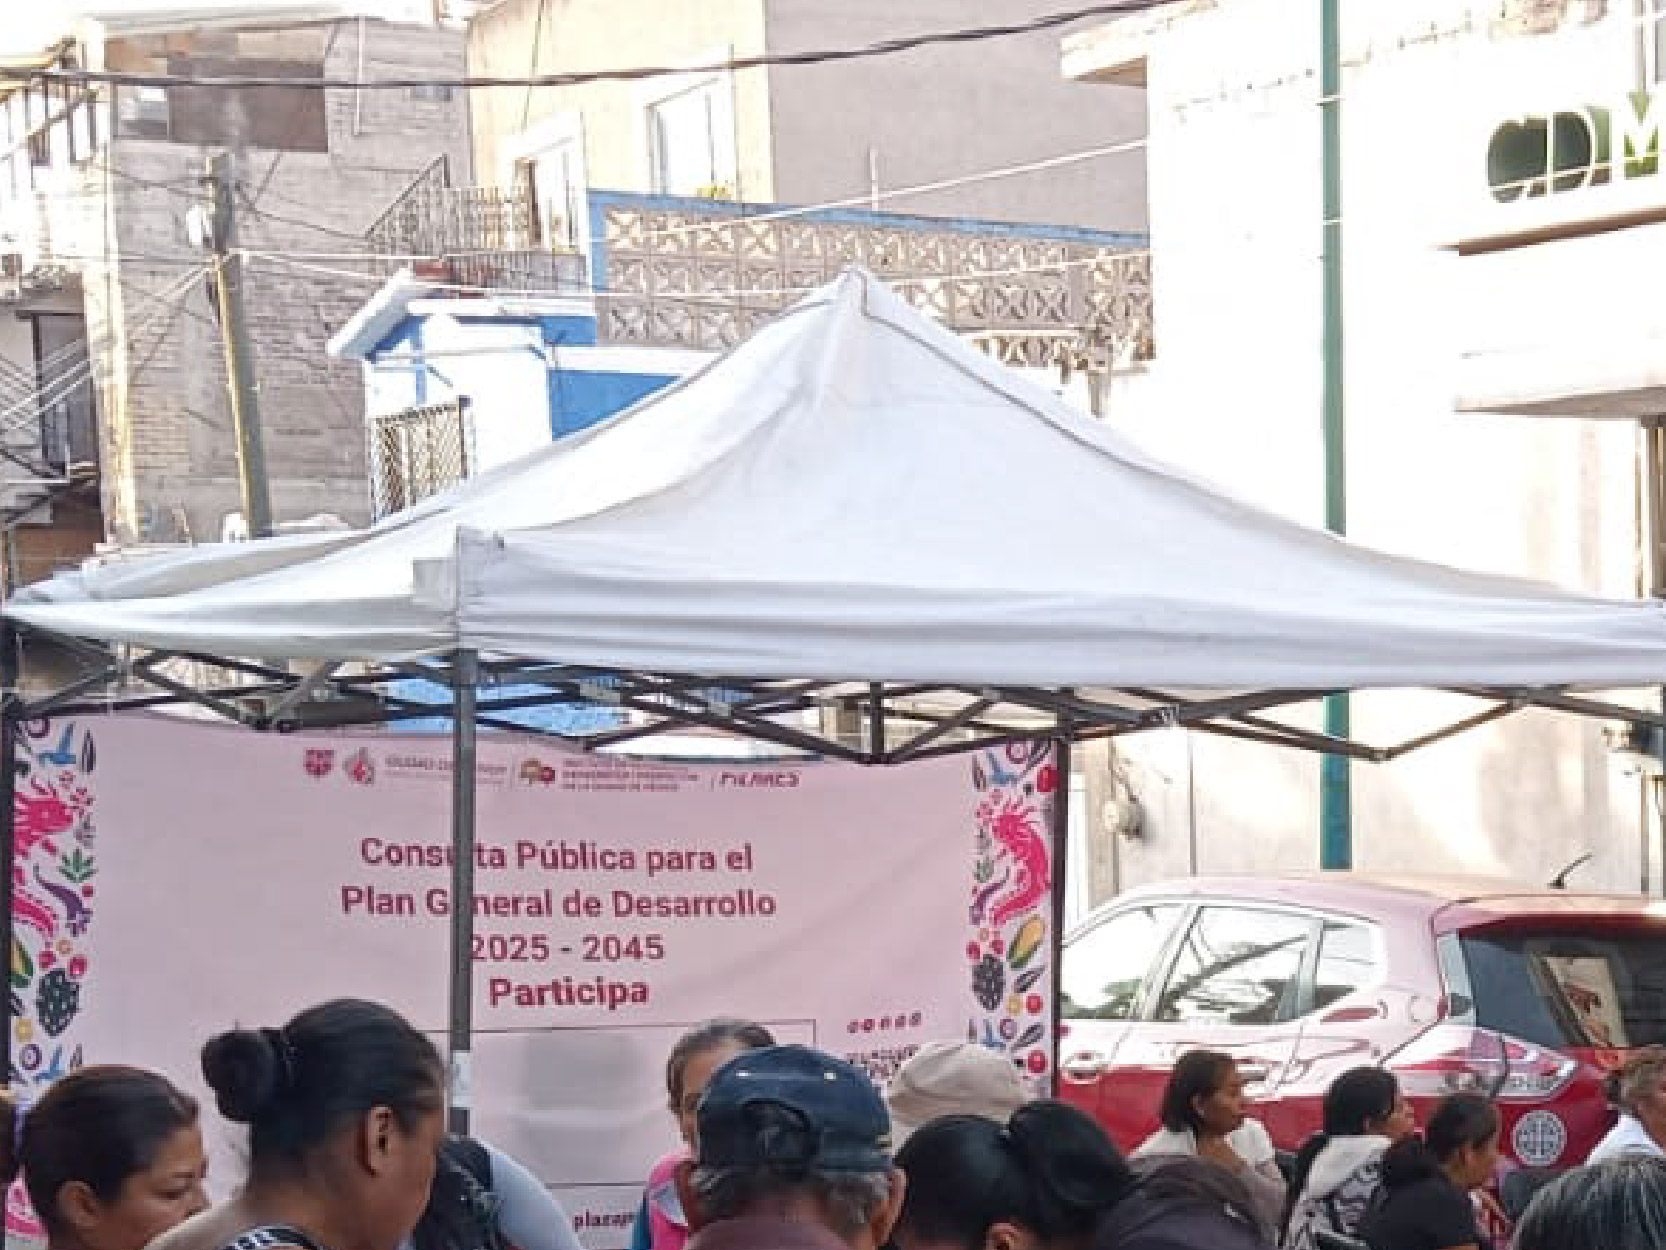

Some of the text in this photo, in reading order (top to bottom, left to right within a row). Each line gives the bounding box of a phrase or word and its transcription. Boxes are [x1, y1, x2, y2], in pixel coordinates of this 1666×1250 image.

[360, 837, 754, 877] Consta Pública para el
[340, 885, 777, 918] Plan Gneral de Desarrollo
[470, 934, 550, 962] 2025
[582, 934, 665, 962] 2045
[489, 976, 650, 1009] Participa
